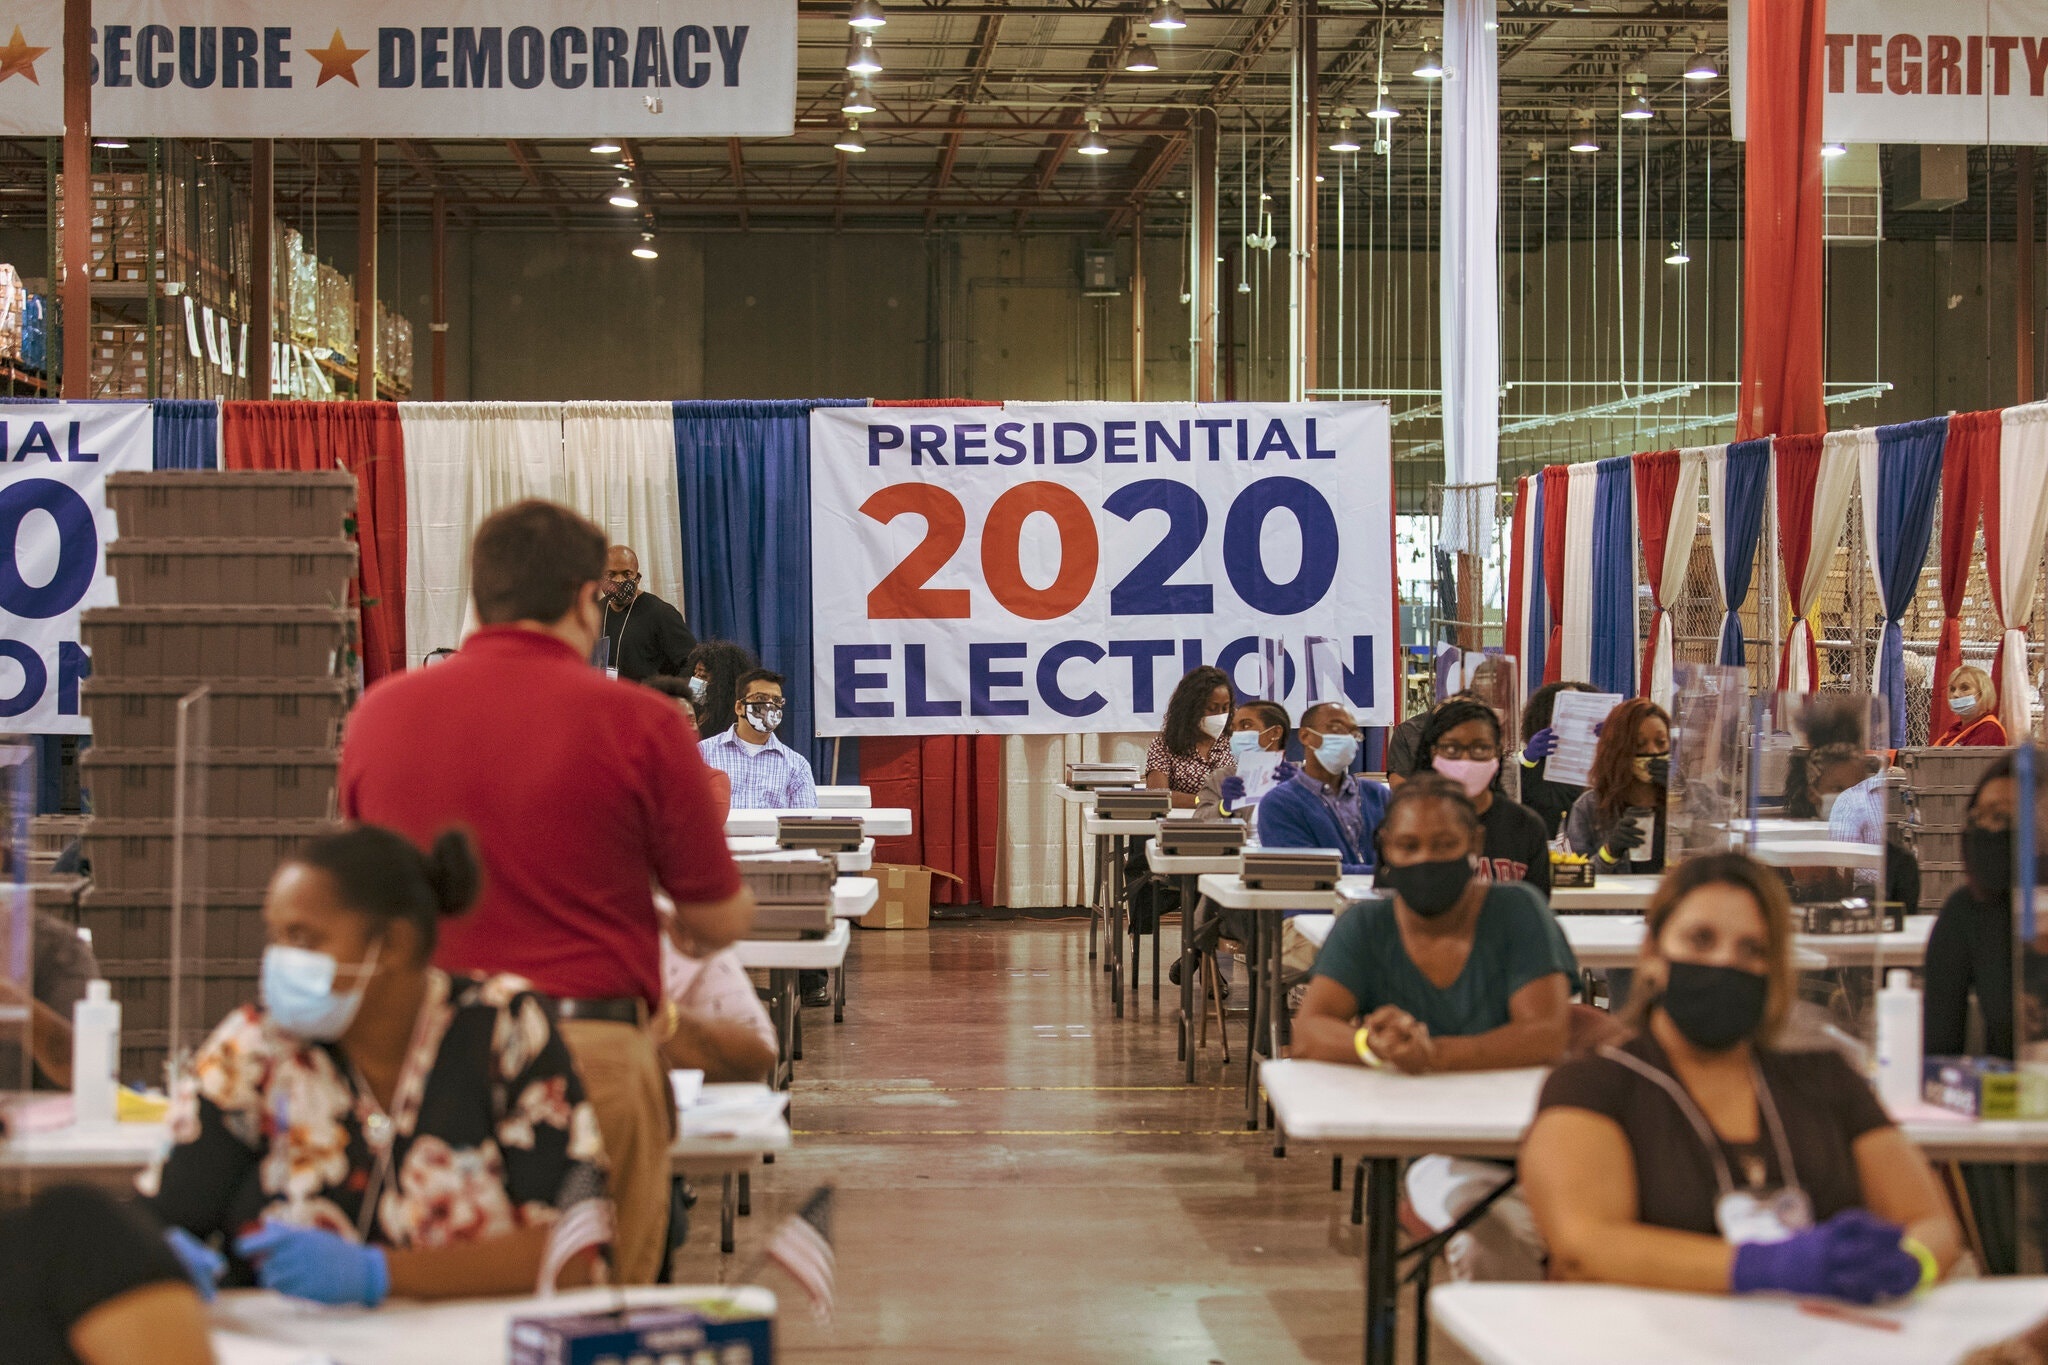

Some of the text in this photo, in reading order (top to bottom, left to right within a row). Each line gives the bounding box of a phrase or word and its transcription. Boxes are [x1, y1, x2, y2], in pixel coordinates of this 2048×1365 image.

[64, 25, 749, 89] ECURE DEMOCRACY
[868, 418, 1336, 466] PRESIDENTIAL
[858, 476, 1339, 620] 2020
